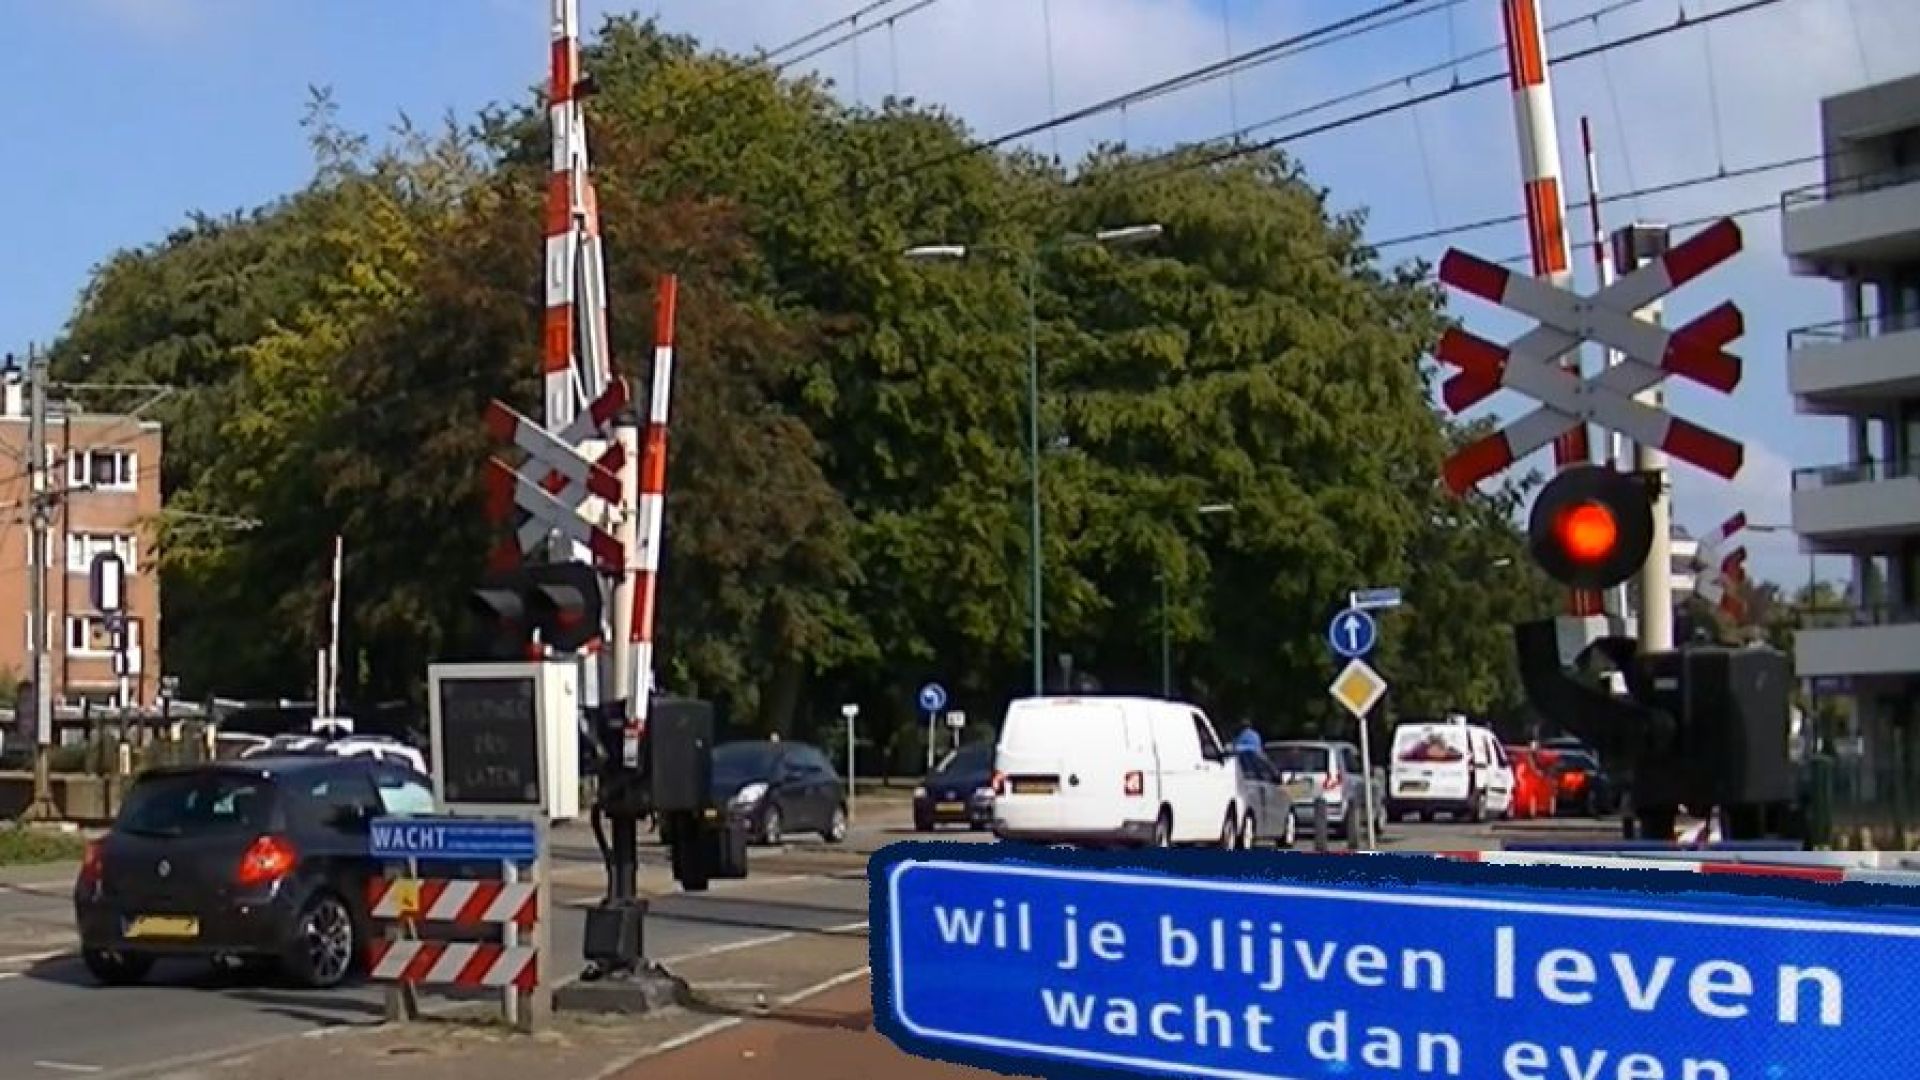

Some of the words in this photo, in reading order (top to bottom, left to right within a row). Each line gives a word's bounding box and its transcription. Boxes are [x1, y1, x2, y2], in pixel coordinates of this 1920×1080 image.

[373, 827, 446, 849] WACHT
[934, 898, 1032, 951] wil
[1058, 905, 1126, 969] je
[1159, 914, 1446, 992] blijven
[1495, 926, 1843, 1026] leven
[1041, 988, 1273, 1053] wacht
[1307, 1010, 1461, 1075] dan
